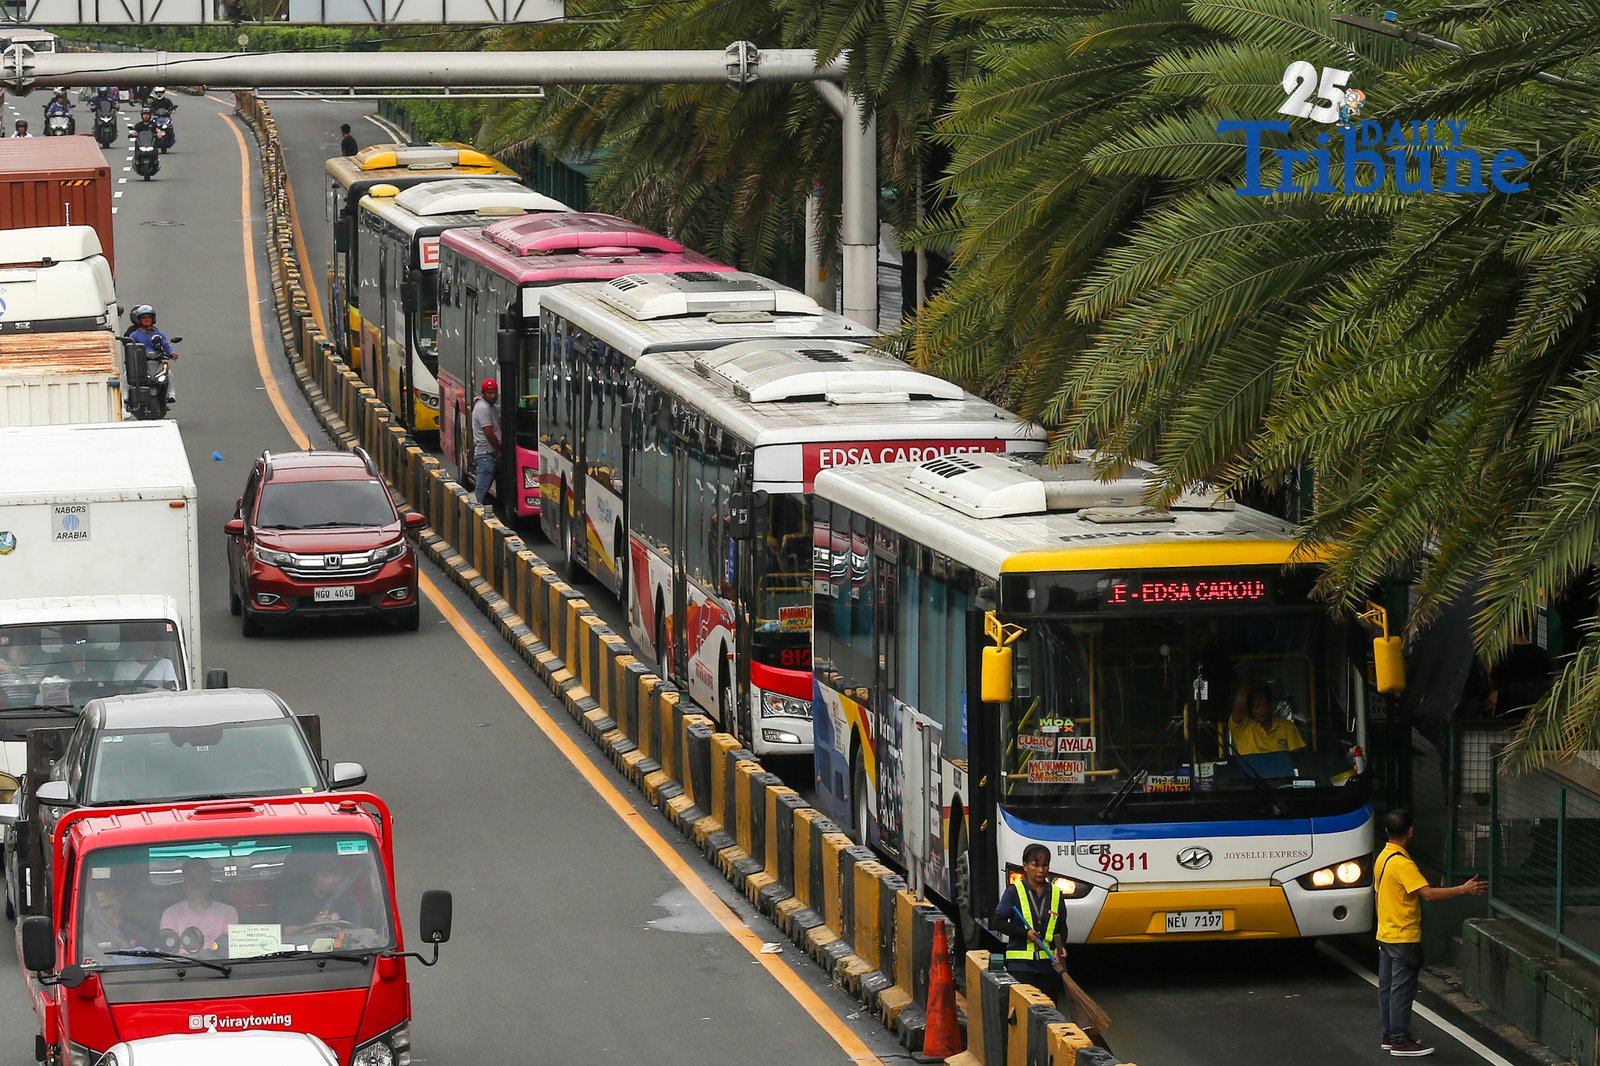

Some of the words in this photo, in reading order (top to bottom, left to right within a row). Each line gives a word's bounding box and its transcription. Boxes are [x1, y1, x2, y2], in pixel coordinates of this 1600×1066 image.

[819, 448, 875, 469] EDSA
[55, 505, 87, 514] NABORS
[56, 531, 88, 540] ARABIA
[335, 589, 353, 598] 4040
[1142, 583, 1192, 602] EDSA
[1195, 580, 1264, 601] CAROU
[1040, 718, 1075, 727] MOA
[1018, 735, 1055, 748] CUBAO
[1058, 738, 1094, 752] AYALA
[1029, 761, 1083, 774] MONUMENTO
[1057, 843, 1111, 856] HIGER
[1224, 851, 1268, 860] JOYSELLE
[1269, 850, 1308, 859] EXPRESS
[1099, 852, 1148, 872] 9811
[1167, 916, 1187, 929] NEV
[1194, 915, 1222, 928] 7197
[219, 1013, 292, 1029] viraytowing
